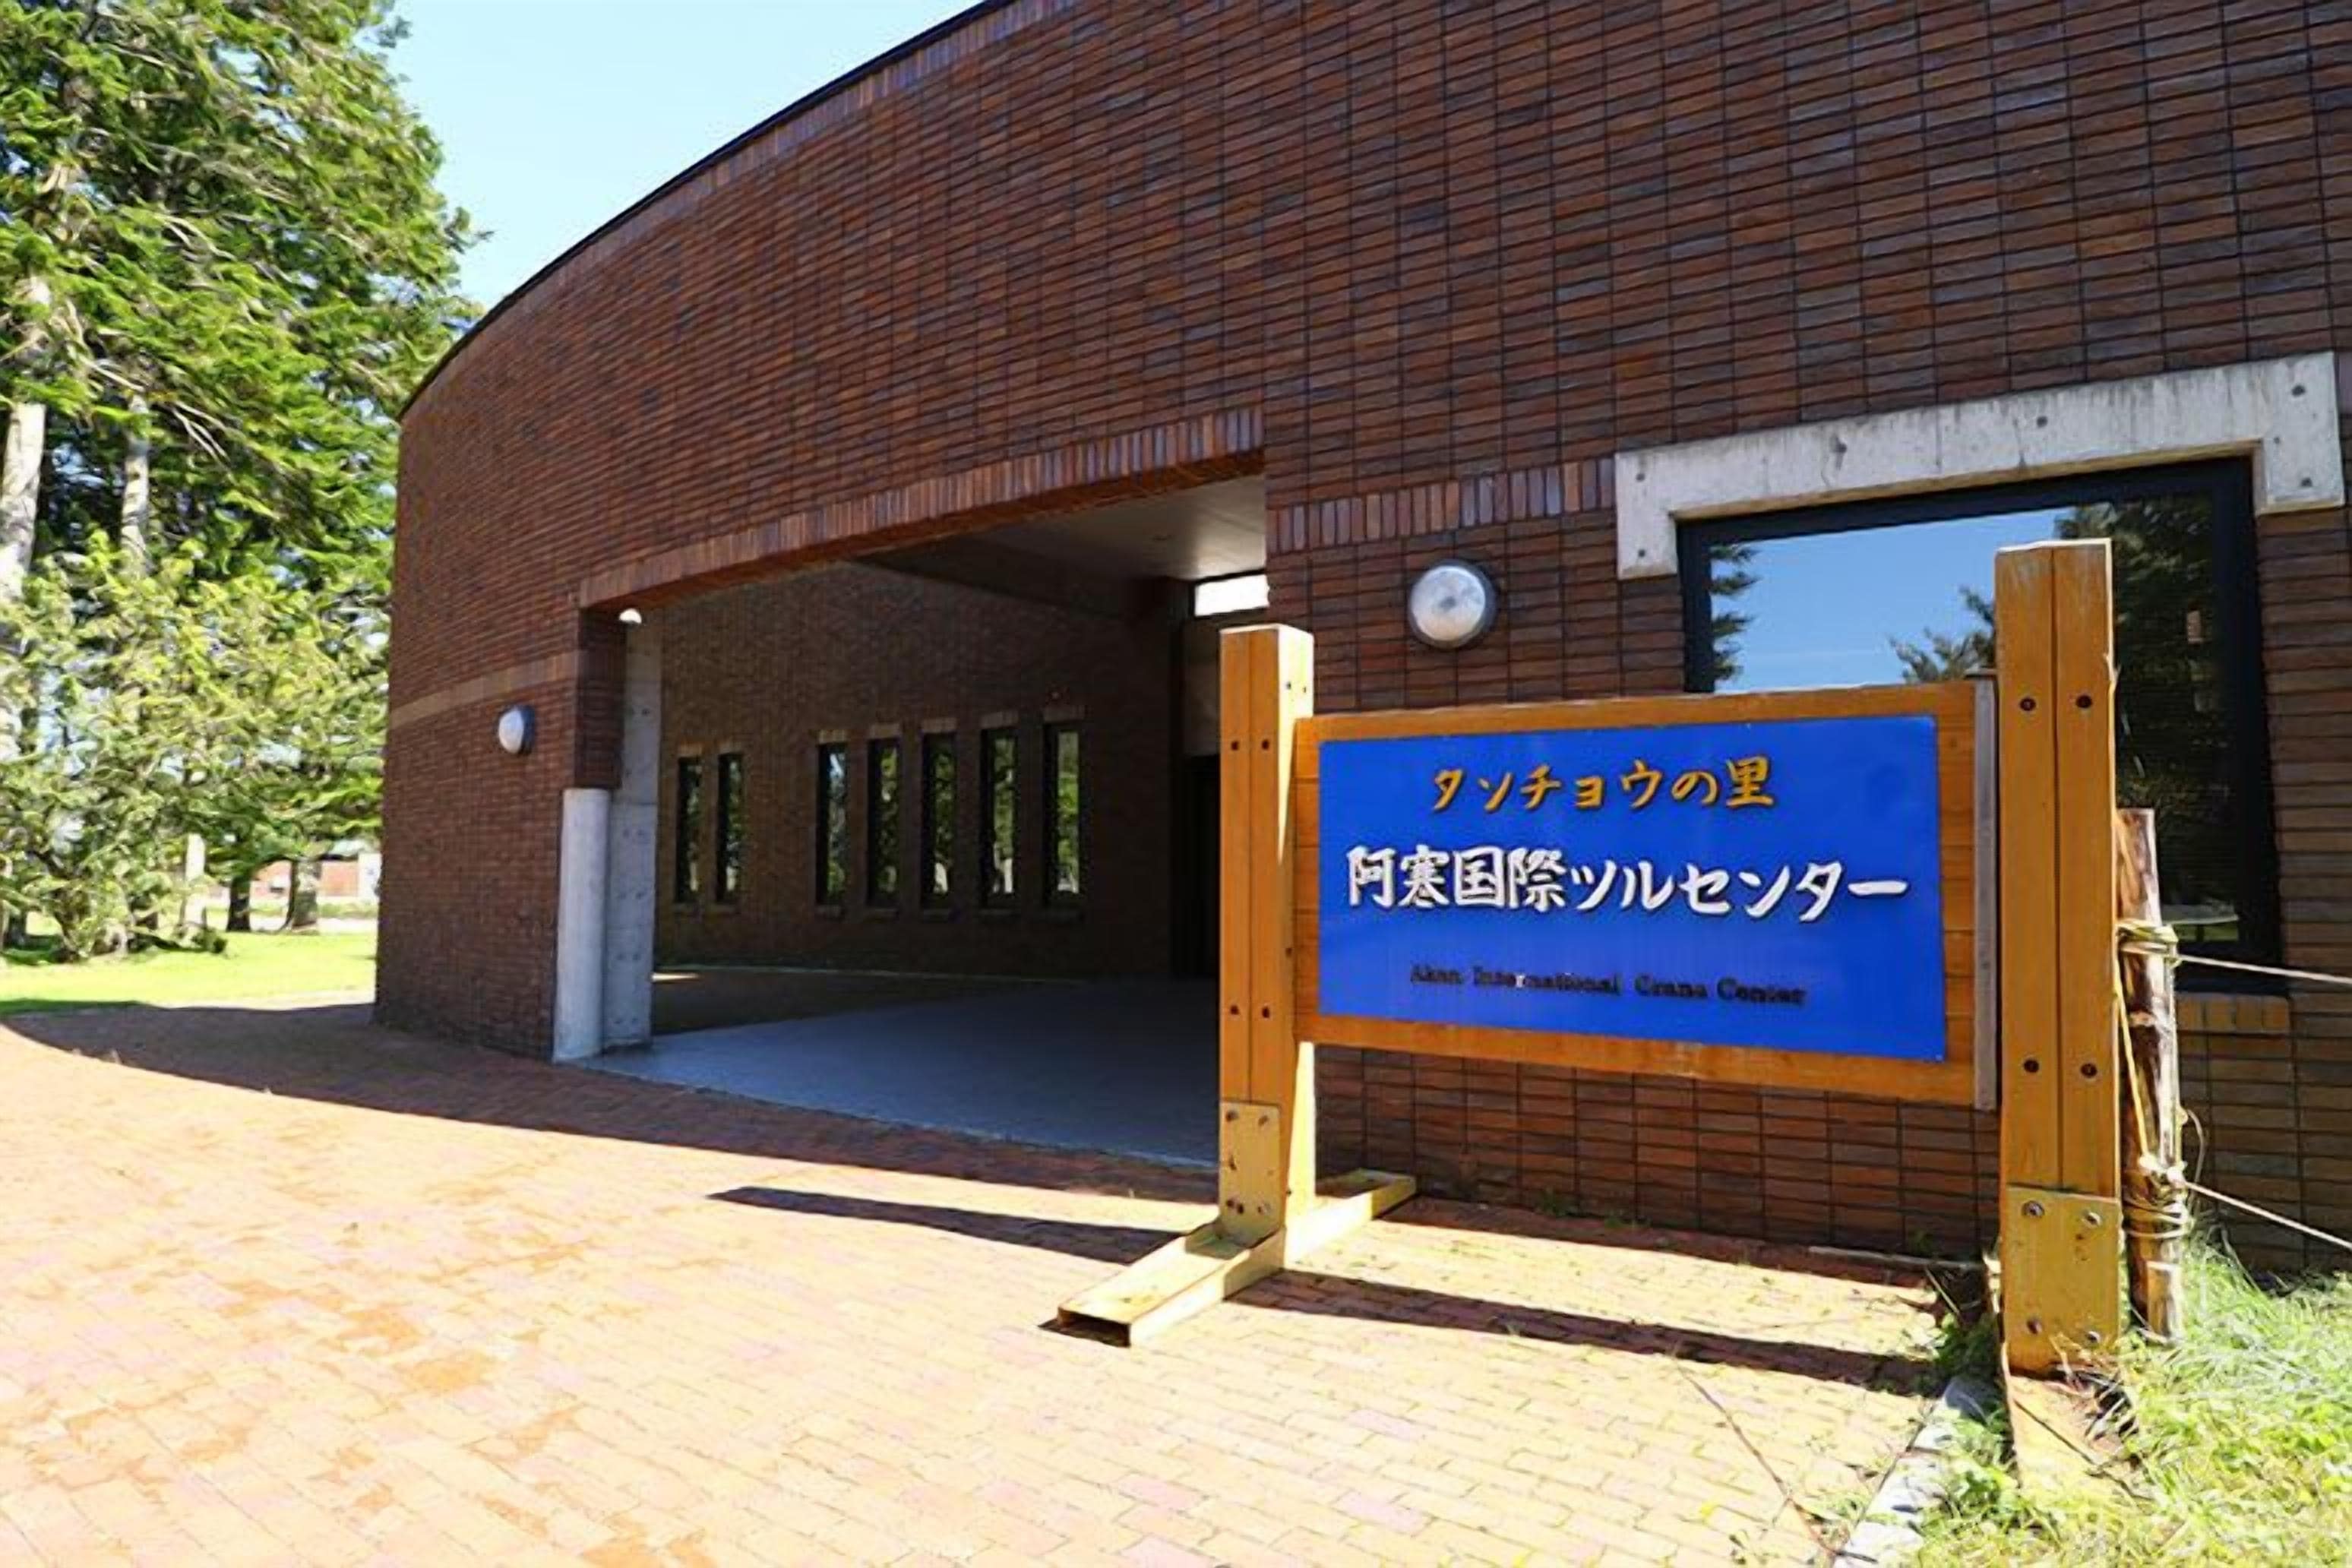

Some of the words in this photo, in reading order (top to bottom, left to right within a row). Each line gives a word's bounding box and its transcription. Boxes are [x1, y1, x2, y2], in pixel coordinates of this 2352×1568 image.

[1347, 844, 1909, 922] 阿寒国際ツルセンター
